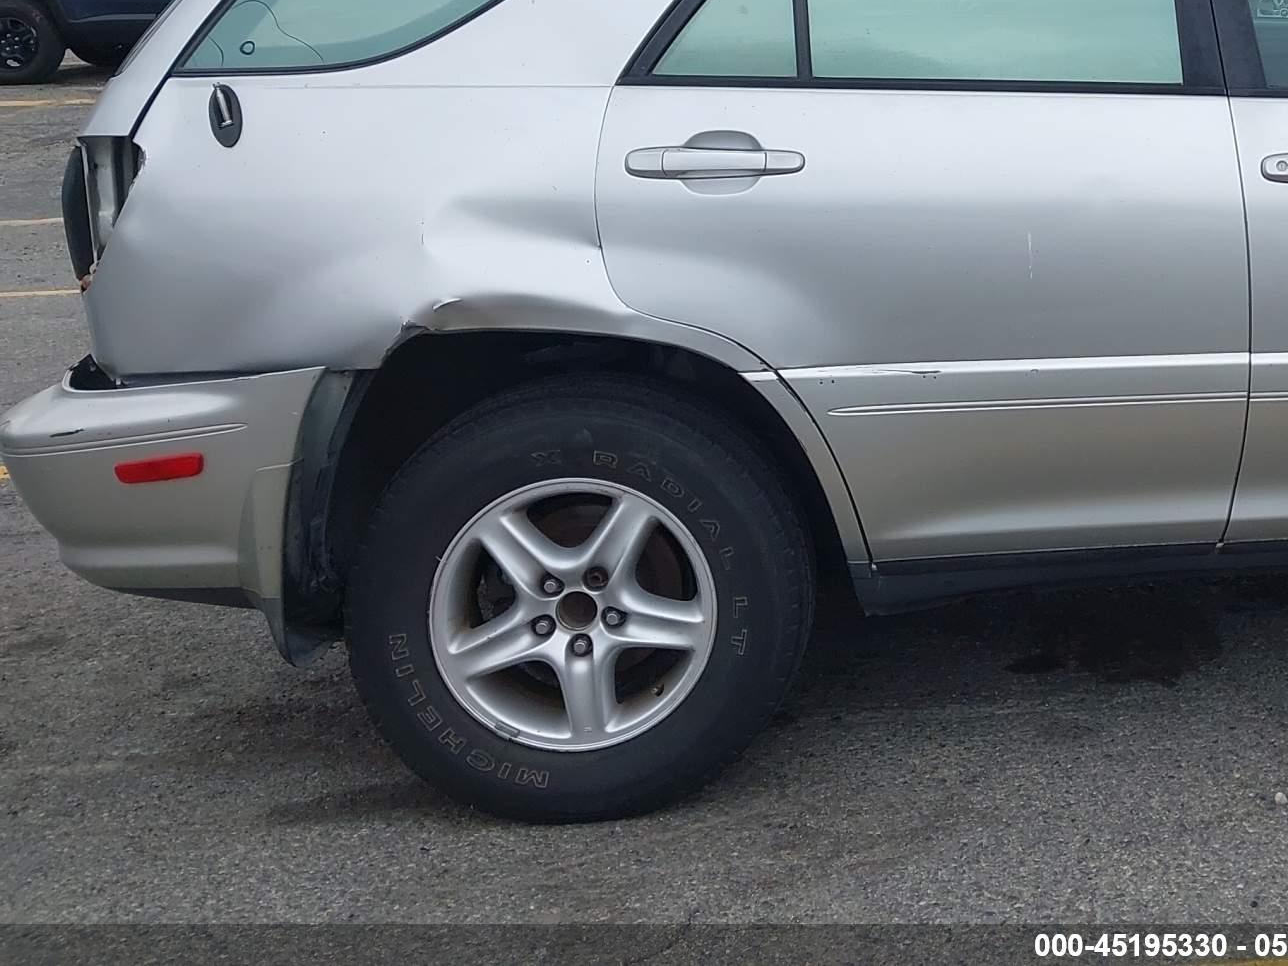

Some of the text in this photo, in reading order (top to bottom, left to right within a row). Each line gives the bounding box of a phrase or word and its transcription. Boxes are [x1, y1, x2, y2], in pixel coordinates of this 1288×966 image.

[592, 449, 736, 571] RADIAL
[730, 595, 749, 657] LT
[388, 633, 550, 789] MICHELIN
